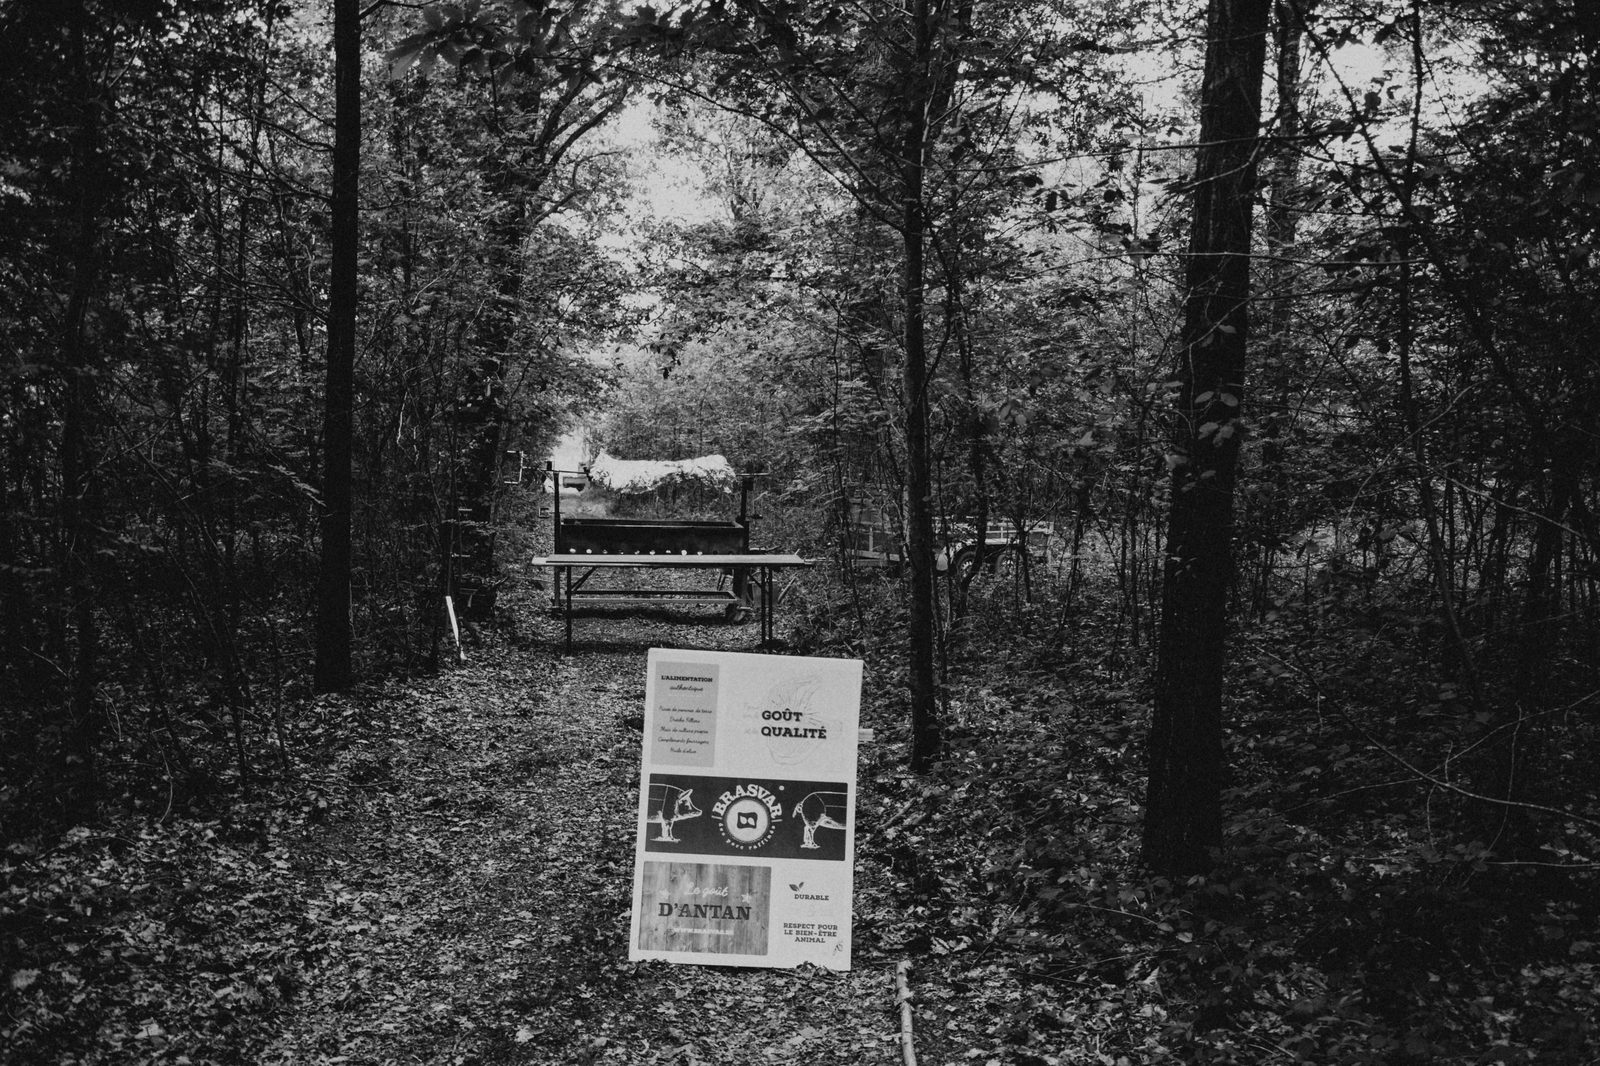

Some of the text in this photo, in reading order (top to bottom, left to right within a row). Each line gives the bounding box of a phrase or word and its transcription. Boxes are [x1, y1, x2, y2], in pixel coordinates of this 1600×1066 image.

[762, 708, 803, 721] GOÛT
[761, 726, 826, 739] QUALITÉ
[712, 784, 782, 818] BRASVAR
[703, 886, 728, 898] goût
[658, 902, 752, 920] D'ANTAN
